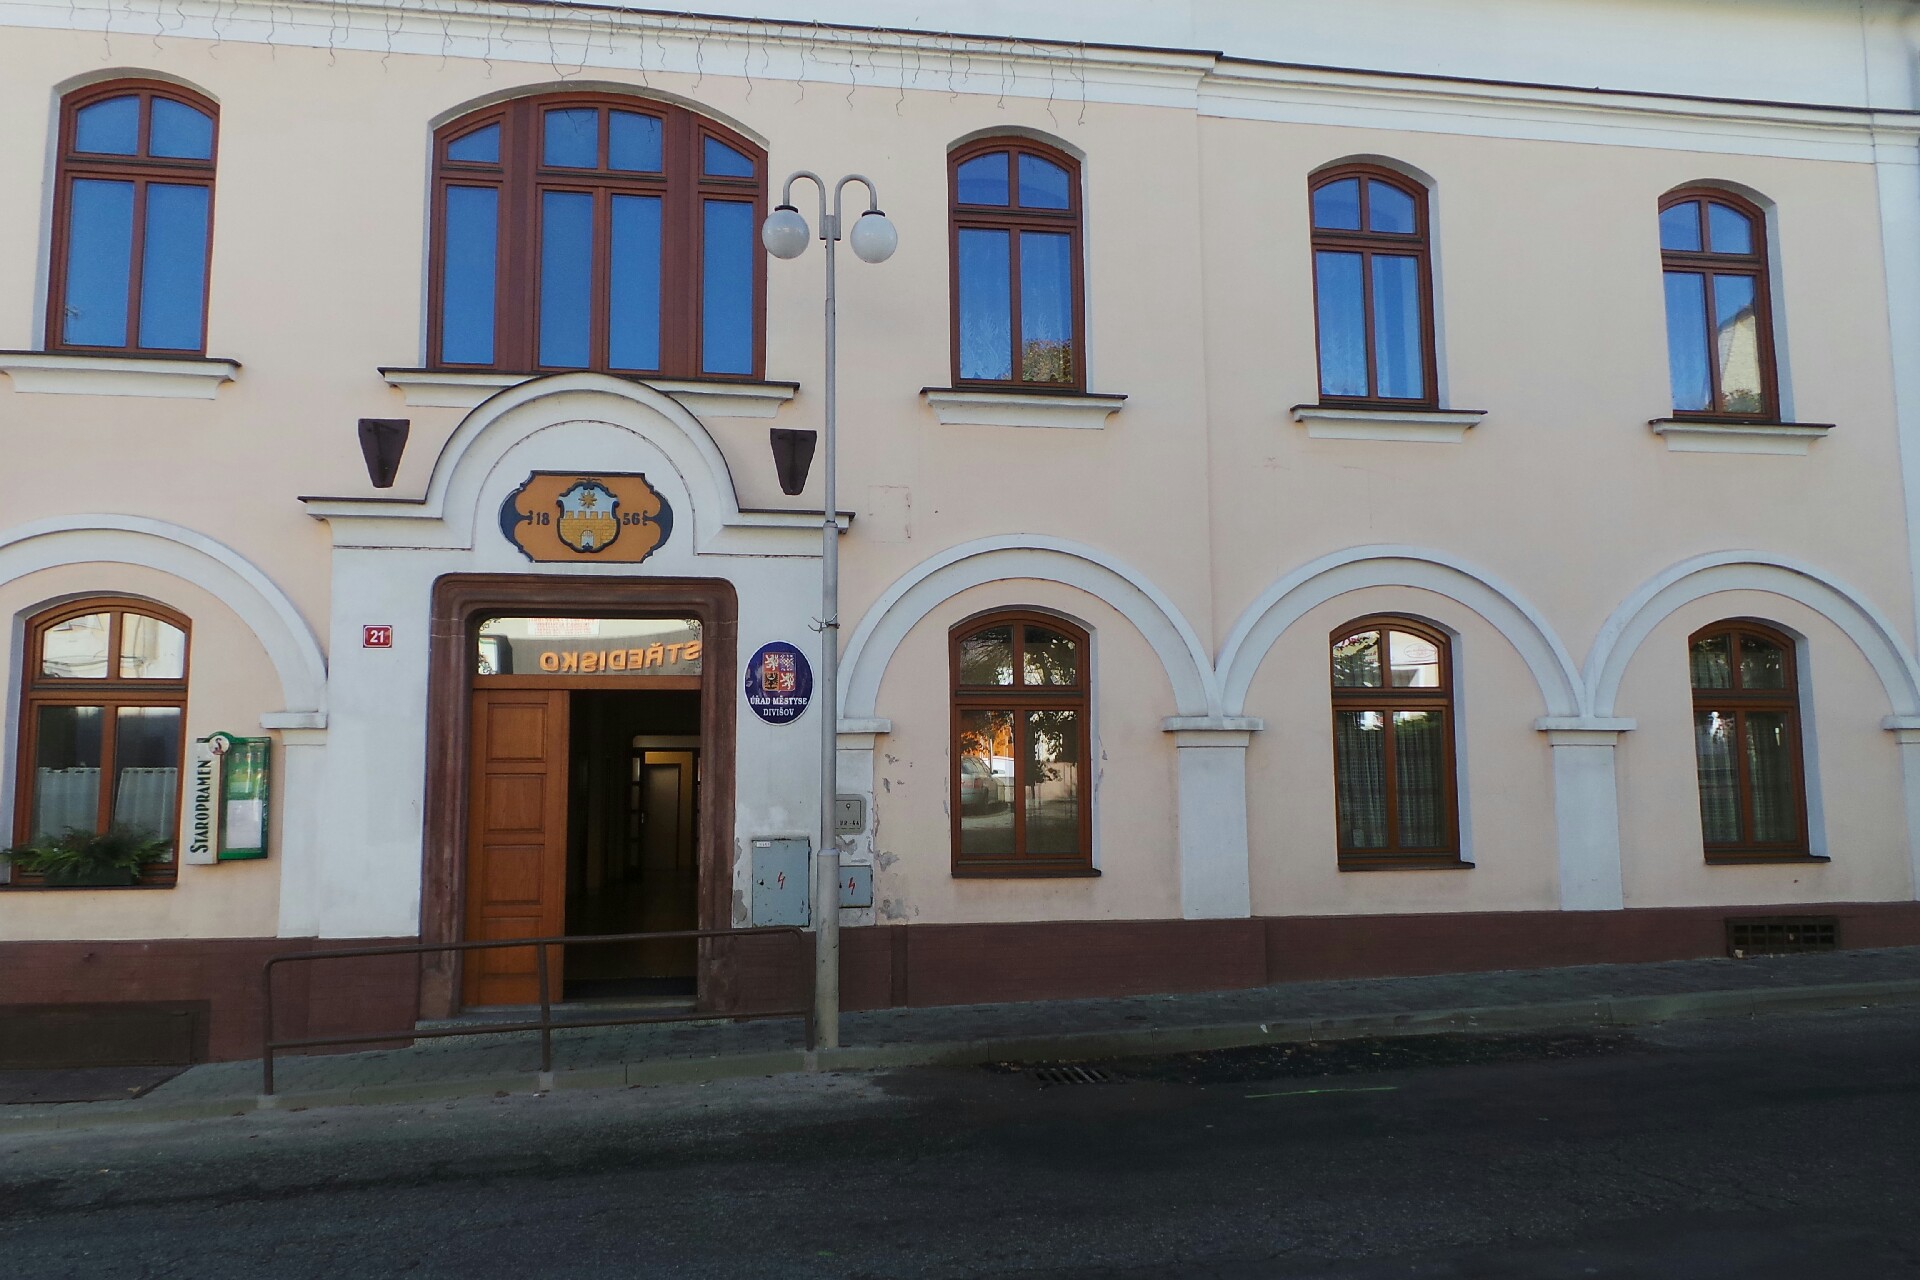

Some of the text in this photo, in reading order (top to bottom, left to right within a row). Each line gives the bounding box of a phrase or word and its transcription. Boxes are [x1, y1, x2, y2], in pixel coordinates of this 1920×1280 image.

[536, 512, 640, 526] 18 56
[370, 629, 385, 644] 21
[750, 694, 808, 705] ÚŘAD MĚSTYSE
[763, 706, 795, 716] DIVIŠOV
[190, 760, 212, 853] STAROPRAMEN
